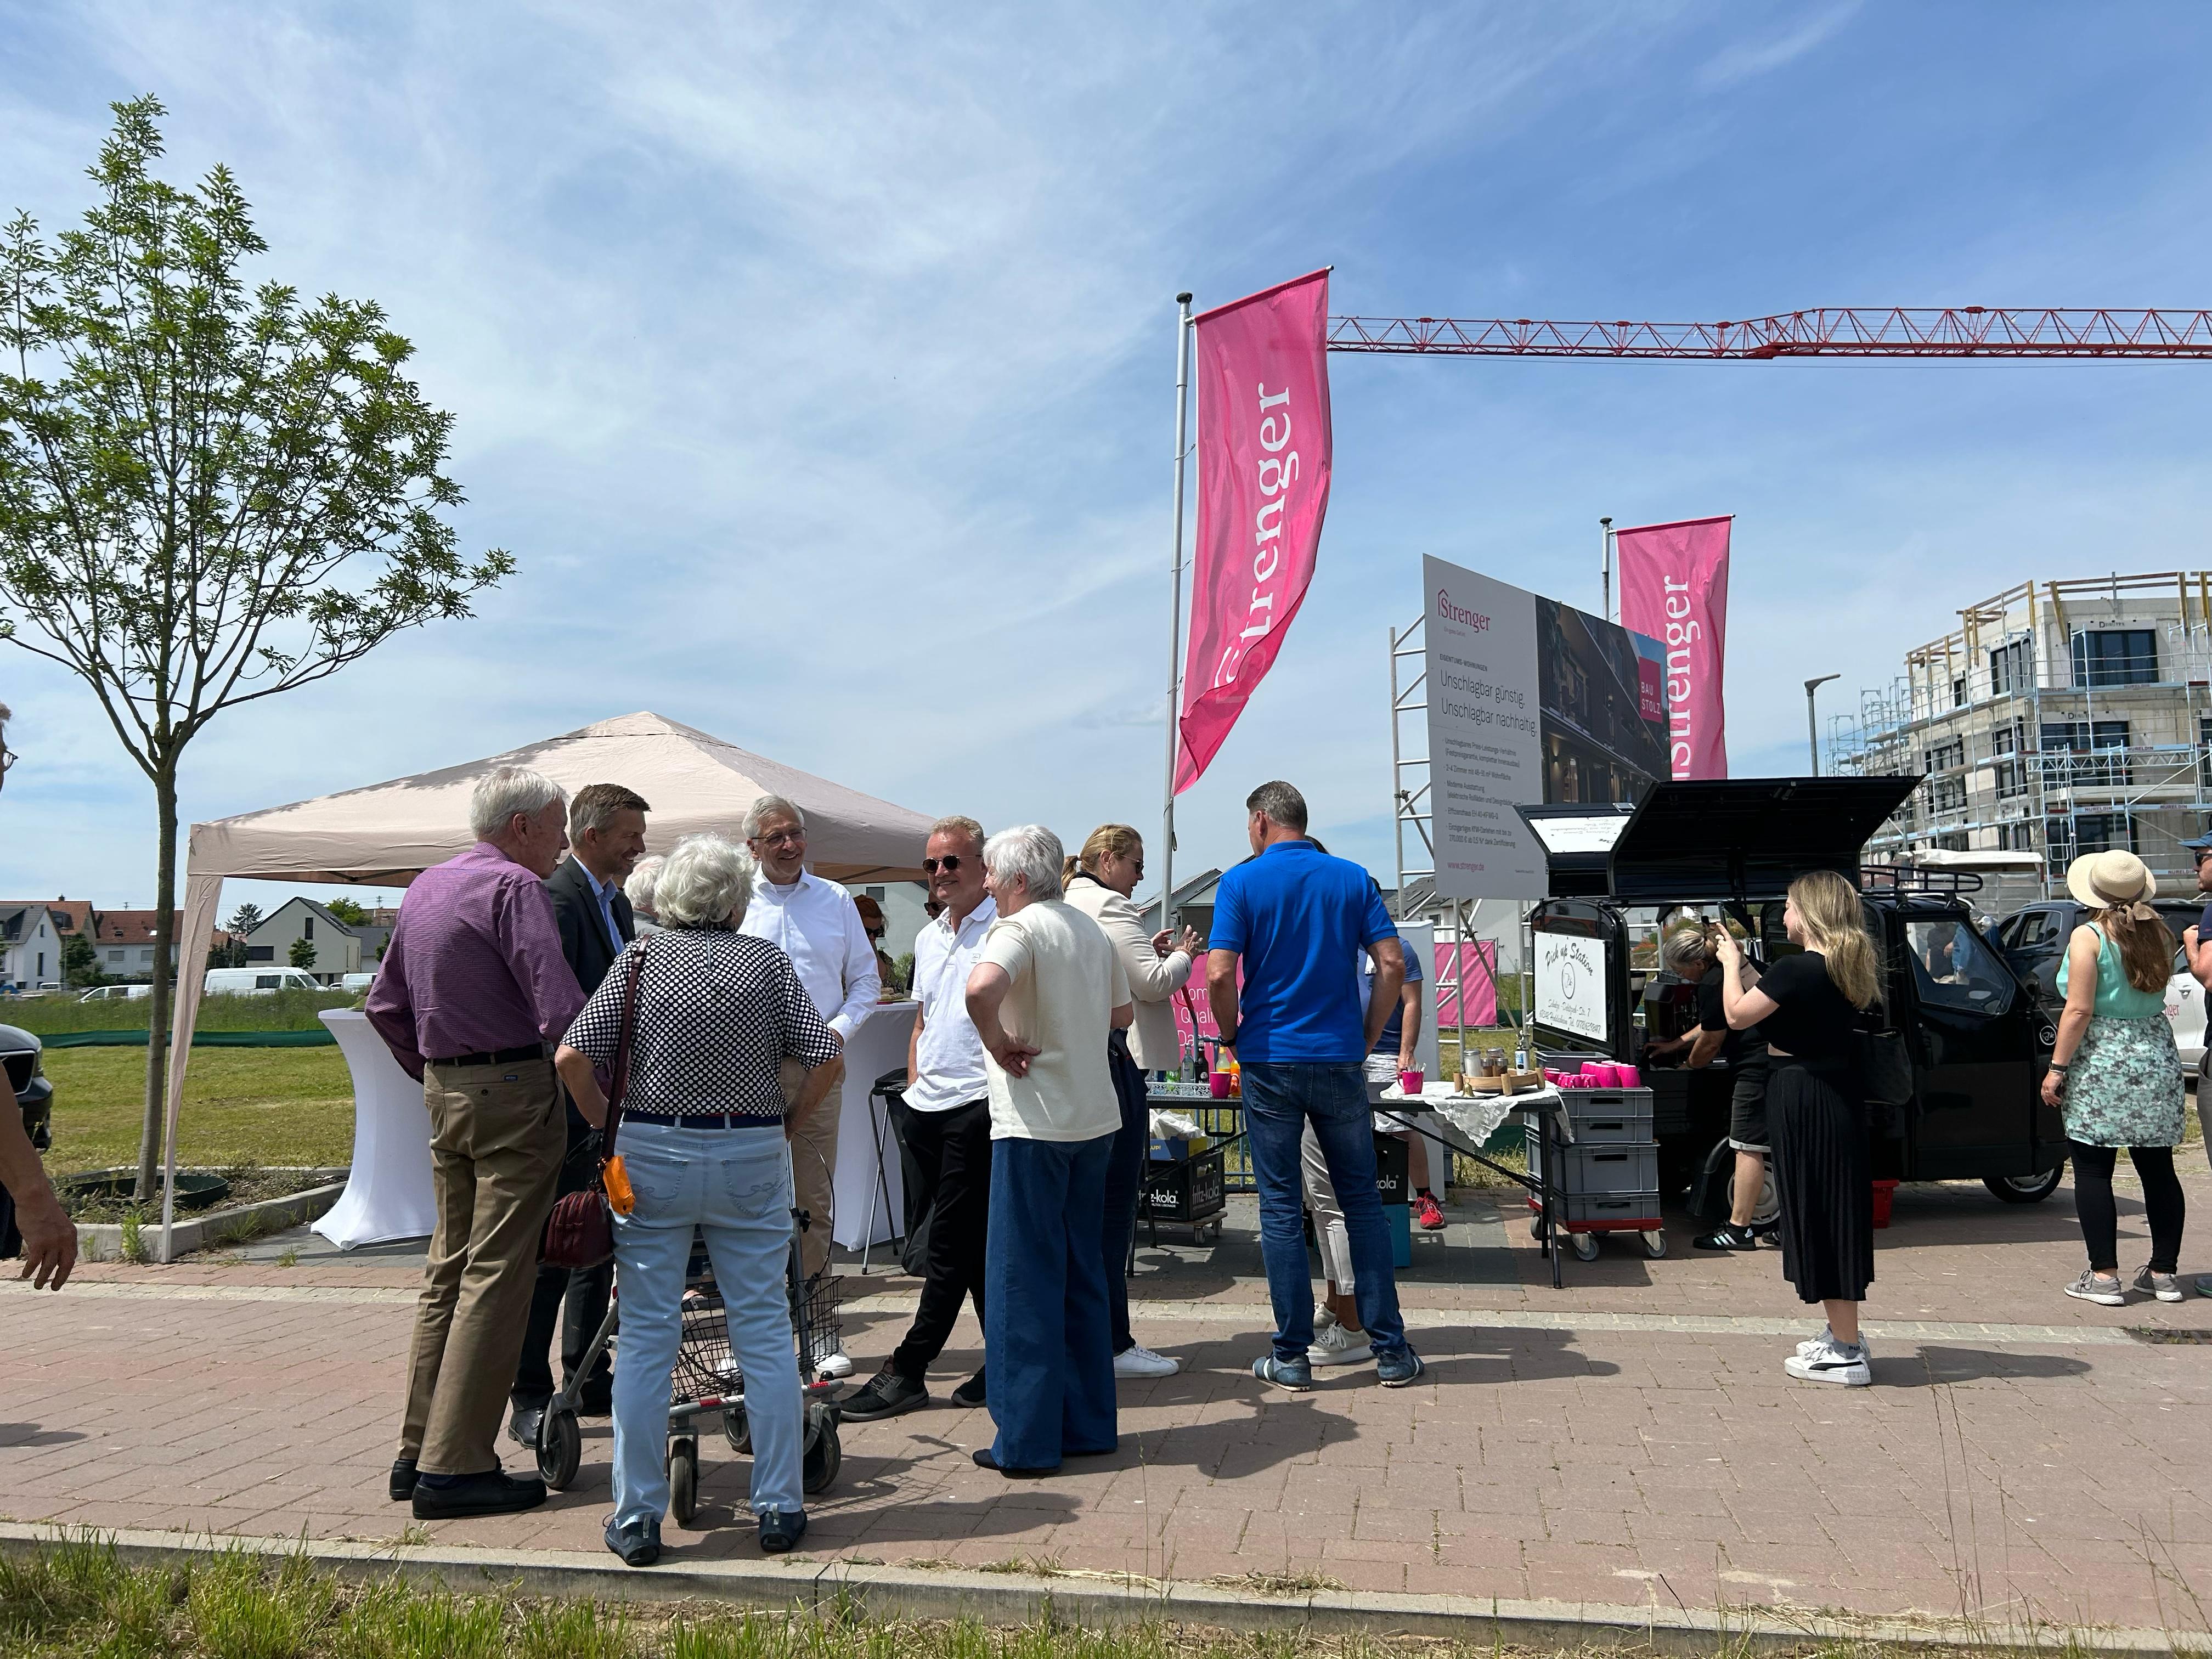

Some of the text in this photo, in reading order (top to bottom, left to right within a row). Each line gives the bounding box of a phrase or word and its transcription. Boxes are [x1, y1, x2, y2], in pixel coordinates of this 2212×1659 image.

[1441, 597, 1491, 633] Strenger
[1441, 669, 1525, 709] Unschlagbar günstig.
[1641, 681, 1654, 696] BAU
[1442, 698, 1537, 737] Unschlagbar nachhaltig.
[1641, 698, 1661, 714] STOLZ
[1447, 862, 1485, 873] www.strenger.de
[1570, 943, 1593, 977] Station
[1192, 1179, 1220, 1205] fritz-kola
